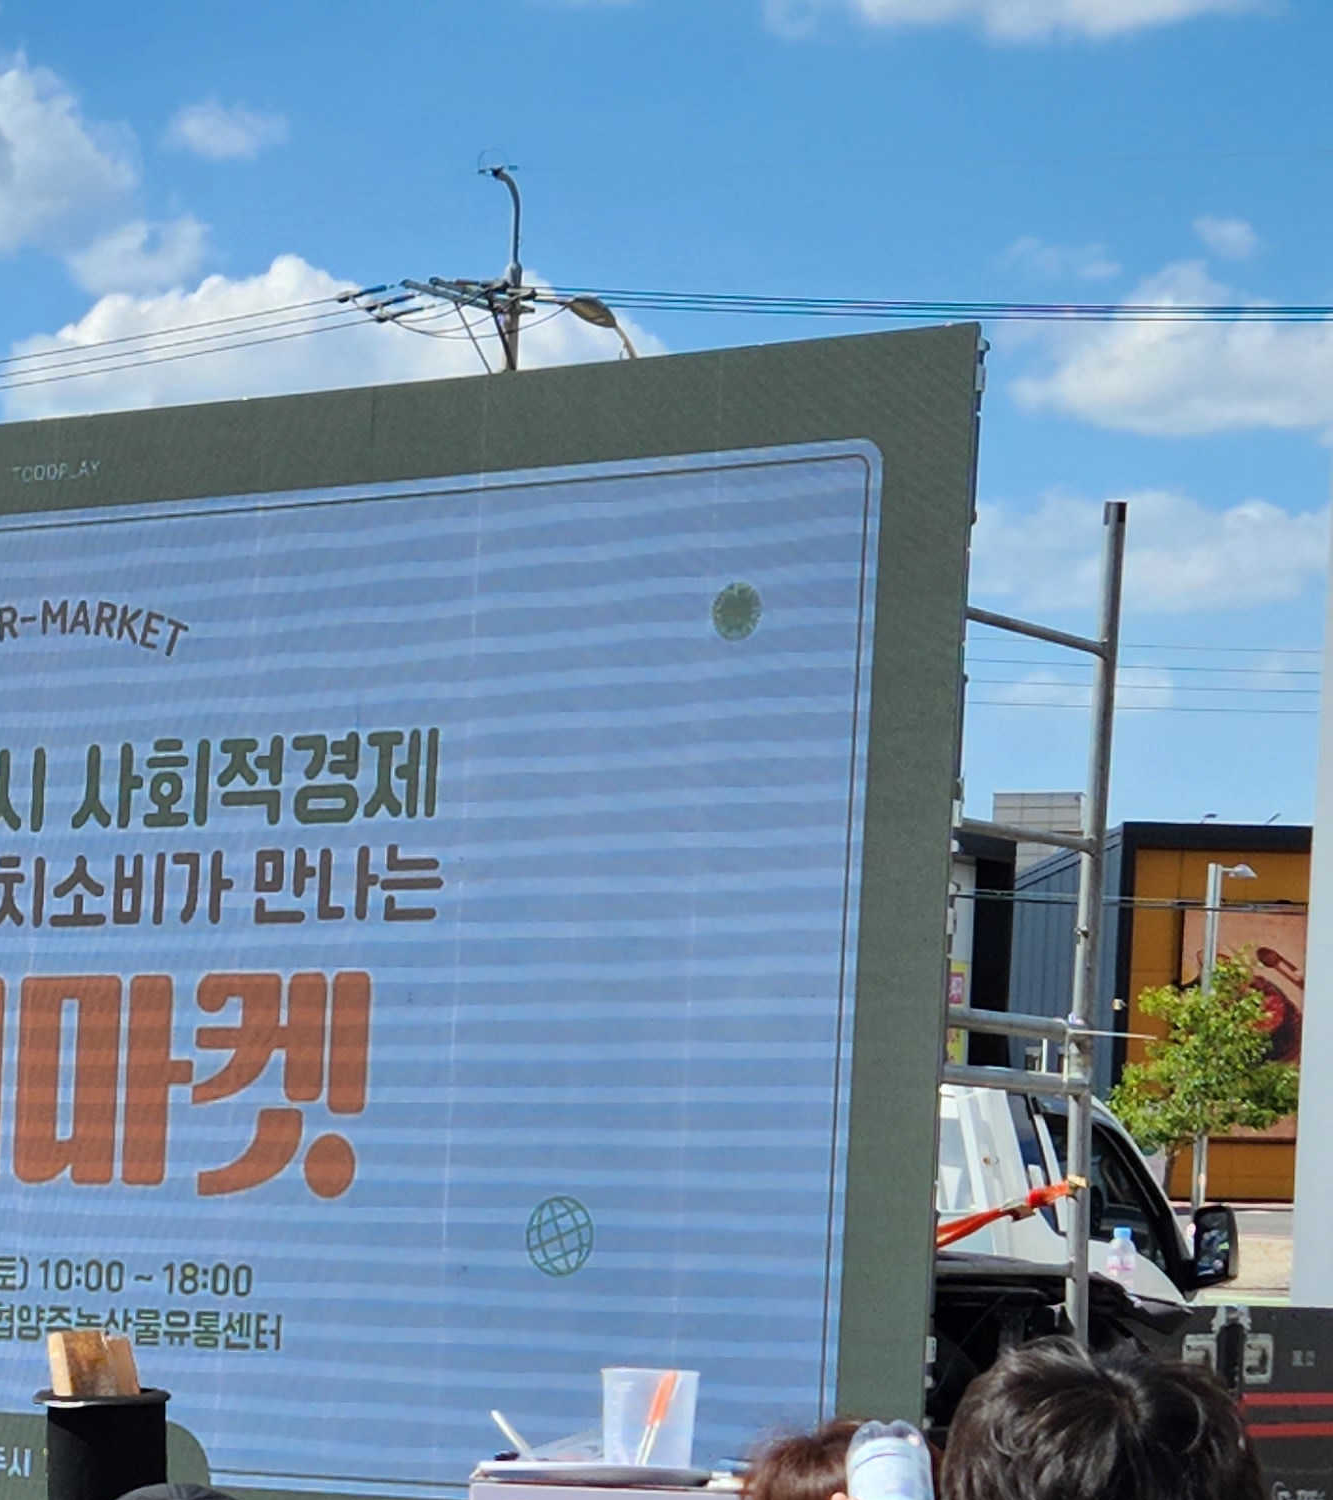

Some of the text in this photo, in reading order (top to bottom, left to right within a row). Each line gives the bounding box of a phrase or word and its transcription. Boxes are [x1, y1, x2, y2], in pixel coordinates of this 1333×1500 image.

[70, 727, 440, 831] 사회적경제
[253, 844, 443, 922] 만나는
[39, 1259, 124, 1293] 10:00
[162, 1262, 253, 1297] 18:00
